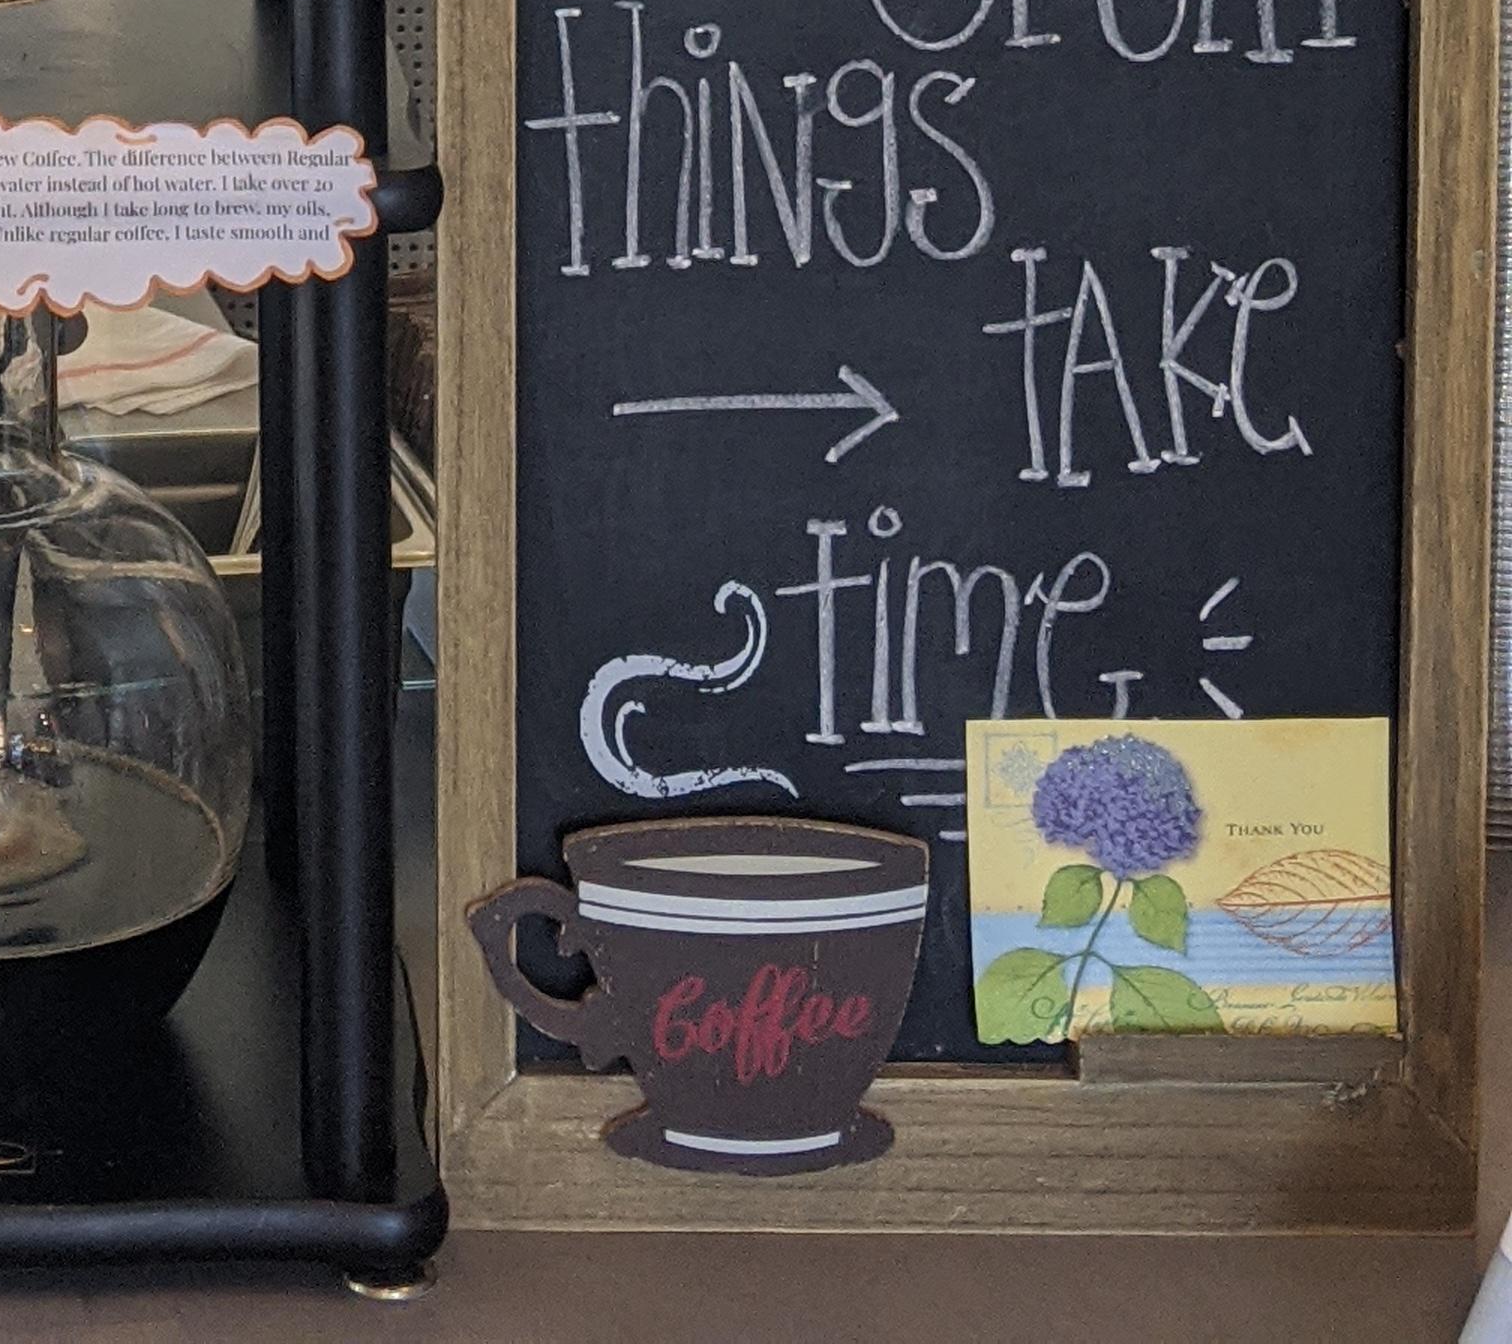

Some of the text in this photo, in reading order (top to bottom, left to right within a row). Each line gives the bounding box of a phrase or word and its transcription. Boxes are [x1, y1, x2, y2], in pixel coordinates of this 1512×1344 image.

[84, 150, 118, 167] The
[122, 150, 206, 167] difference
[210, 150, 282, 167] between
[286, 150, 354, 170] Regular
[46, 175, 108, 192] instead
[112, 175, 132, 192] of
[132, 175, 160, 192] hot
[232, 175, 266, 192] take
[270, 180, 310, 192] over
[312, 180, 334, 192] 20
[20, 200, 98, 219] Although
[114, 200, 148, 216] take
[152, 200, 188, 219] long
[192, 200, 210, 216] to
[266, 205, 290, 219] my
[48, 226, 110, 245] regular
[184, 226, 226, 242] taste
[230, 226, 294, 242] smooth
[298, 226, 330, 242] and
[653, 963, 872, 1087] Coffee
